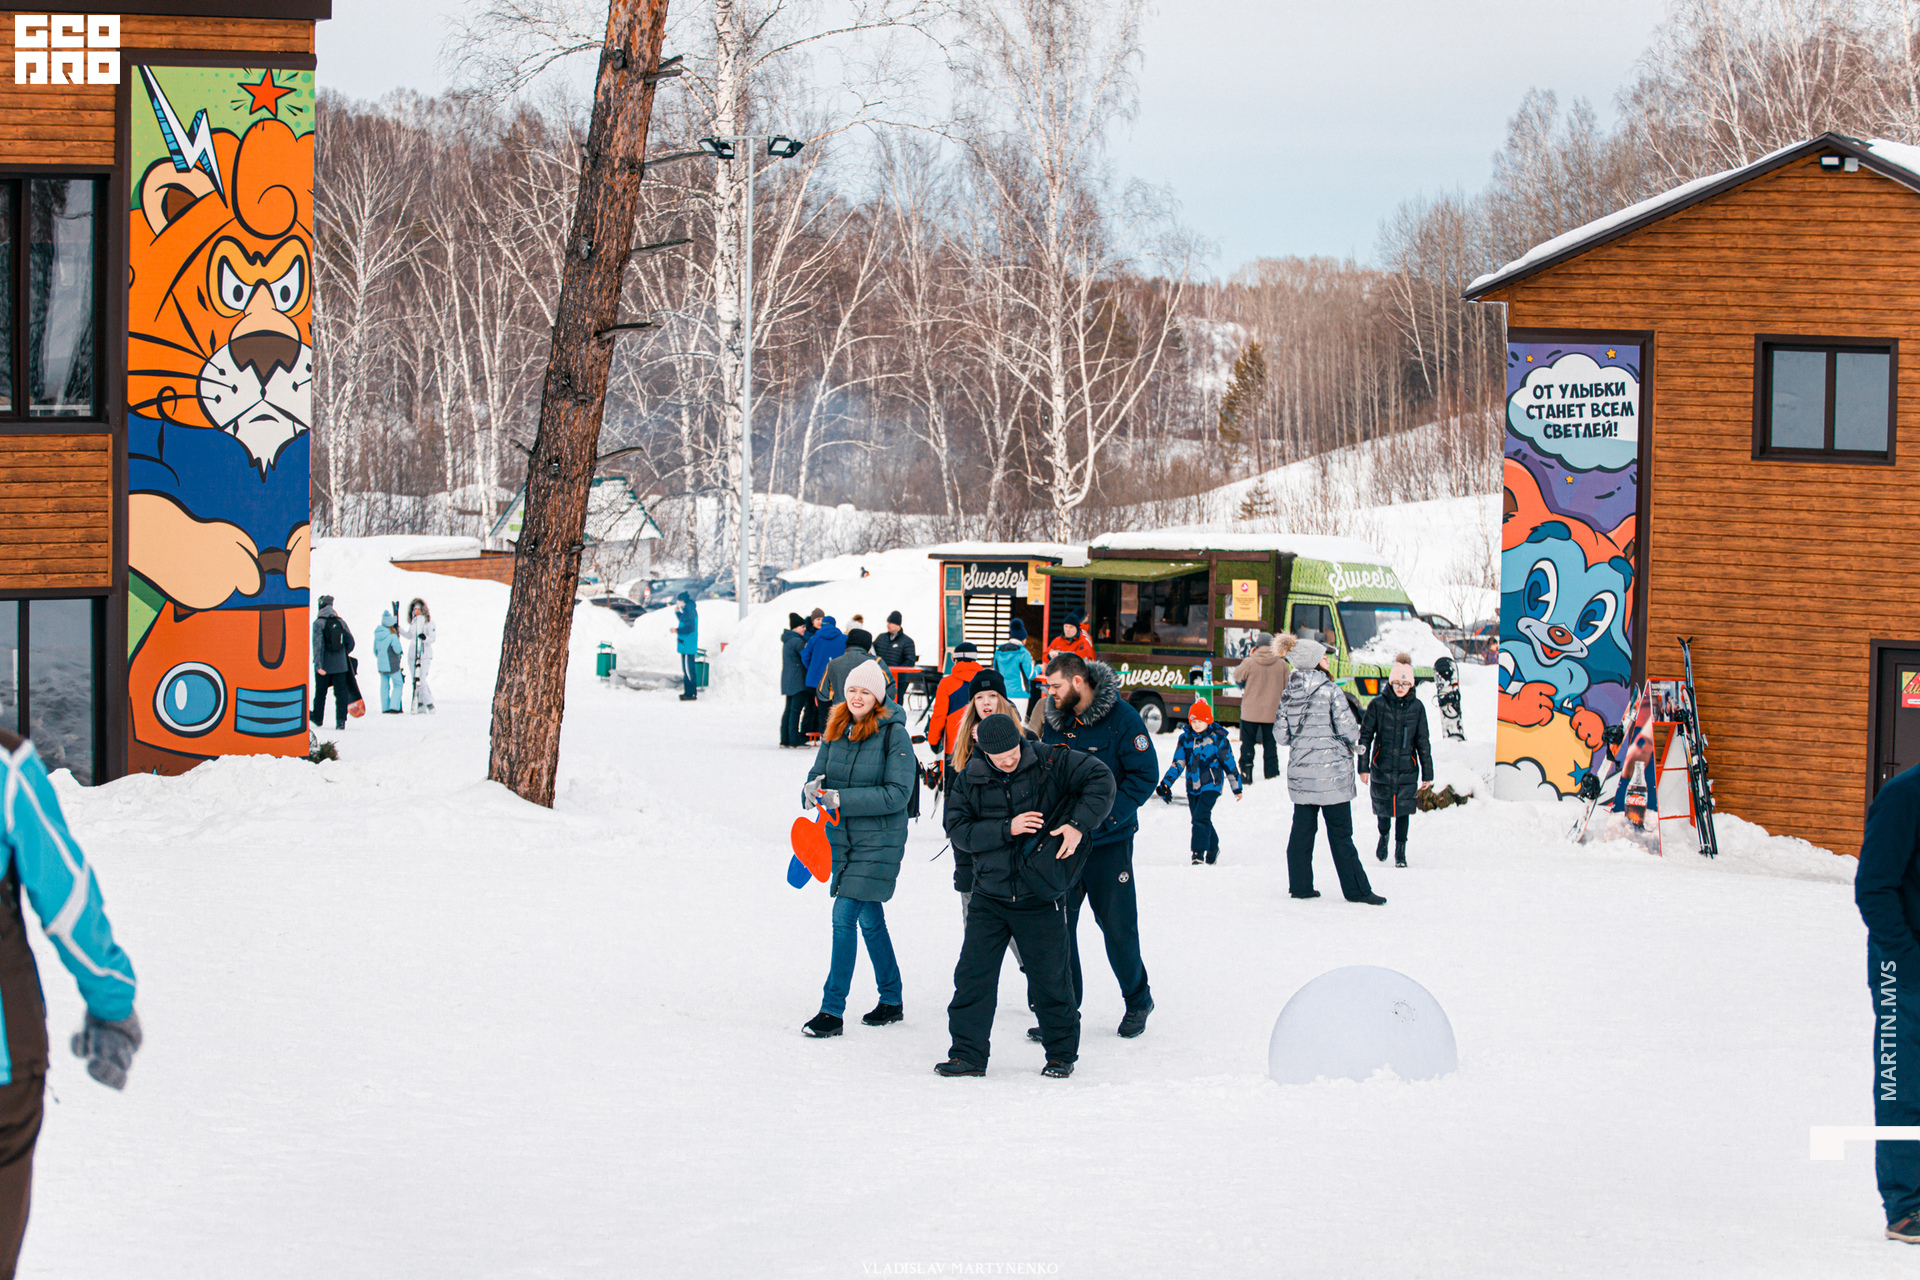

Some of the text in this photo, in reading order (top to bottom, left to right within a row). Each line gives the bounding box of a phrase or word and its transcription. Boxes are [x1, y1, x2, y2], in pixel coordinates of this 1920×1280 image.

[1532, 381, 1626, 400] ОТ УЛЫБКИ
[1525, 400, 1635, 420] СТАНЕТ ВСЕМ
[1542, 419, 1619, 439] СВЕТЛЕЙ!
